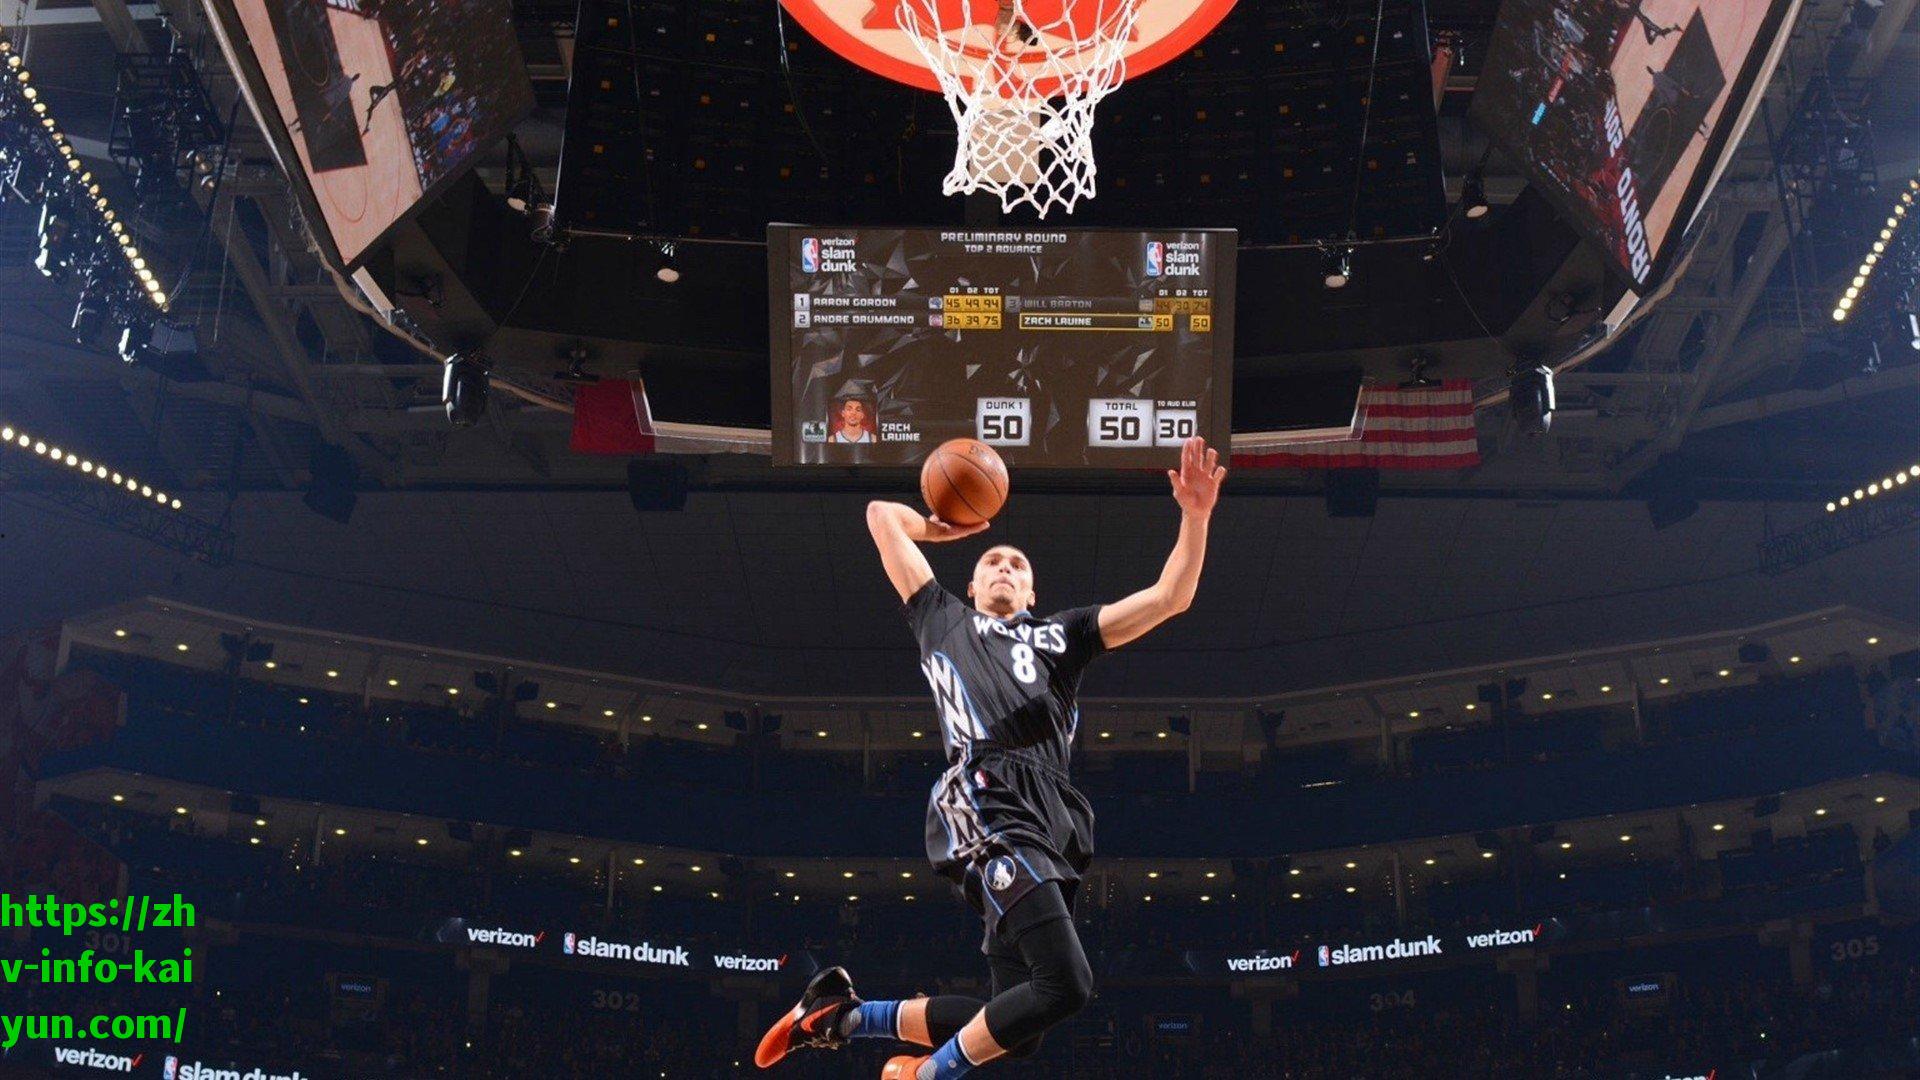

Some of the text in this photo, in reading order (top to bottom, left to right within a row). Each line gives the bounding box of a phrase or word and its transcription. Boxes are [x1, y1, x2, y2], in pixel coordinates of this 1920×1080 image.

[821, 237, 855, 246] verizon
[940, 232, 1067, 243] PRELIMINARY ROUND
[965, 244, 1043, 254] TOP 2 ADVANCE
[1165, 241, 1200, 250] verizon
[821, 246, 856, 259] slam
[1165, 250, 1200, 263] slam
[821, 259, 857, 272] dunk
[1164, 263, 1200, 276] dunk
[983, 286, 1000, 294] TOT
[813, 298, 850, 307] AARON
[852, 298, 897, 307] GORDON
[946, 299, 960, 308] 45
[965, 299, 980, 308] 49
[983, 299, 999, 308] 94
[798, 314, 806, 324] 2
[813, 315, 850, 324] ANDRE
[852, 315, 915, 324] DRUMMOND
[965, 315, 980, 325] 39
[983, 315, 999, 325] 75
[1024, 316, 1052, 325] ZACH
[1156, 317, 1170, 327] 50
[1192, 317, 1209, 327] 50
[986, 401, 1016, 410] DUNK
[1105, 402, 1139, 411] TOTAL
[881, 422, 911, 432] ZACH
[982, 415, 1024, 440] 50
[1100, 416, 1141, 441] 50
[1159, 418, 1193, 439] 30
[973, 616, 1067, 653] WOLVES
[1011, 643, 1037, 684] 8
[466, 926, 535, 947] verizon
[1466, 925, 1534, 948] verizon
[577, 936, 690, 966] slam dunk
[1331, 934, 1443, 965] slam dunk
[713, 953, 779, 972] verizon
[1226, 951, 1292, 972] verizon
[55, 1046, 132, 1073] verizon
